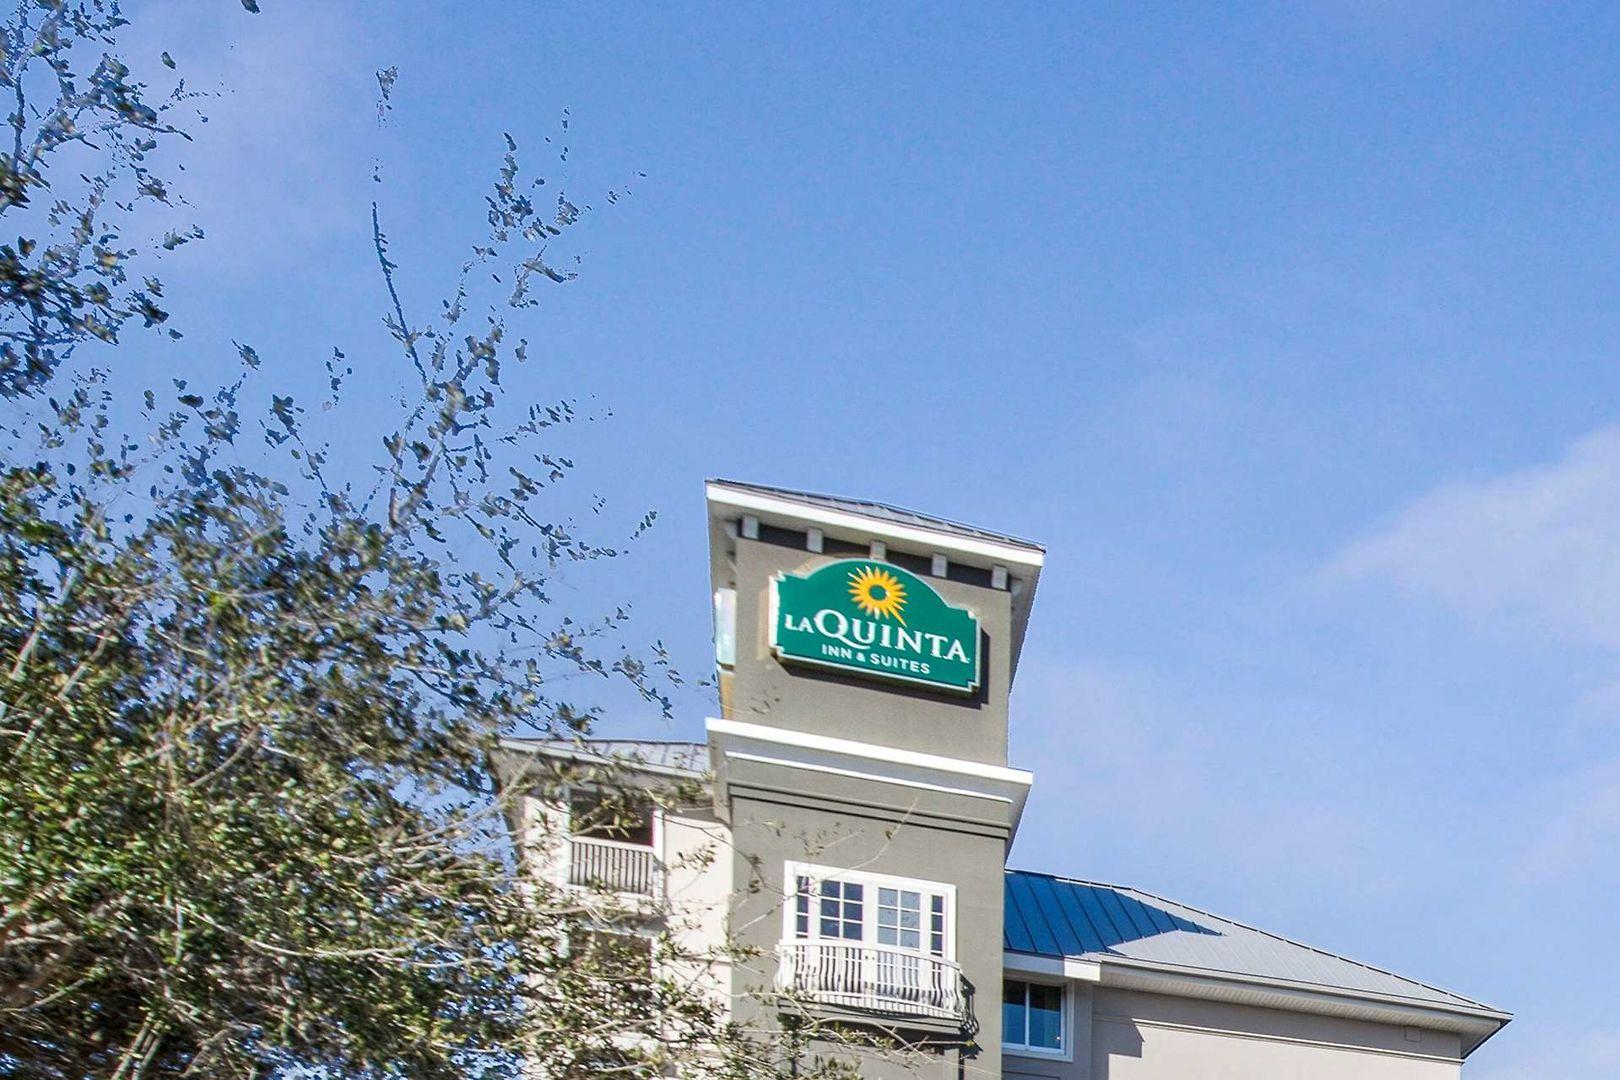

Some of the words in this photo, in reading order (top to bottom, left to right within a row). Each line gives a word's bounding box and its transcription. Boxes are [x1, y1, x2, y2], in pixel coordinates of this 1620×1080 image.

[813, 609, 971, 664] QUINTA
[822, 644, 852, 659] INN
[857, 652, 865, 662] &
[870, 652, 931, 675] SUITES
